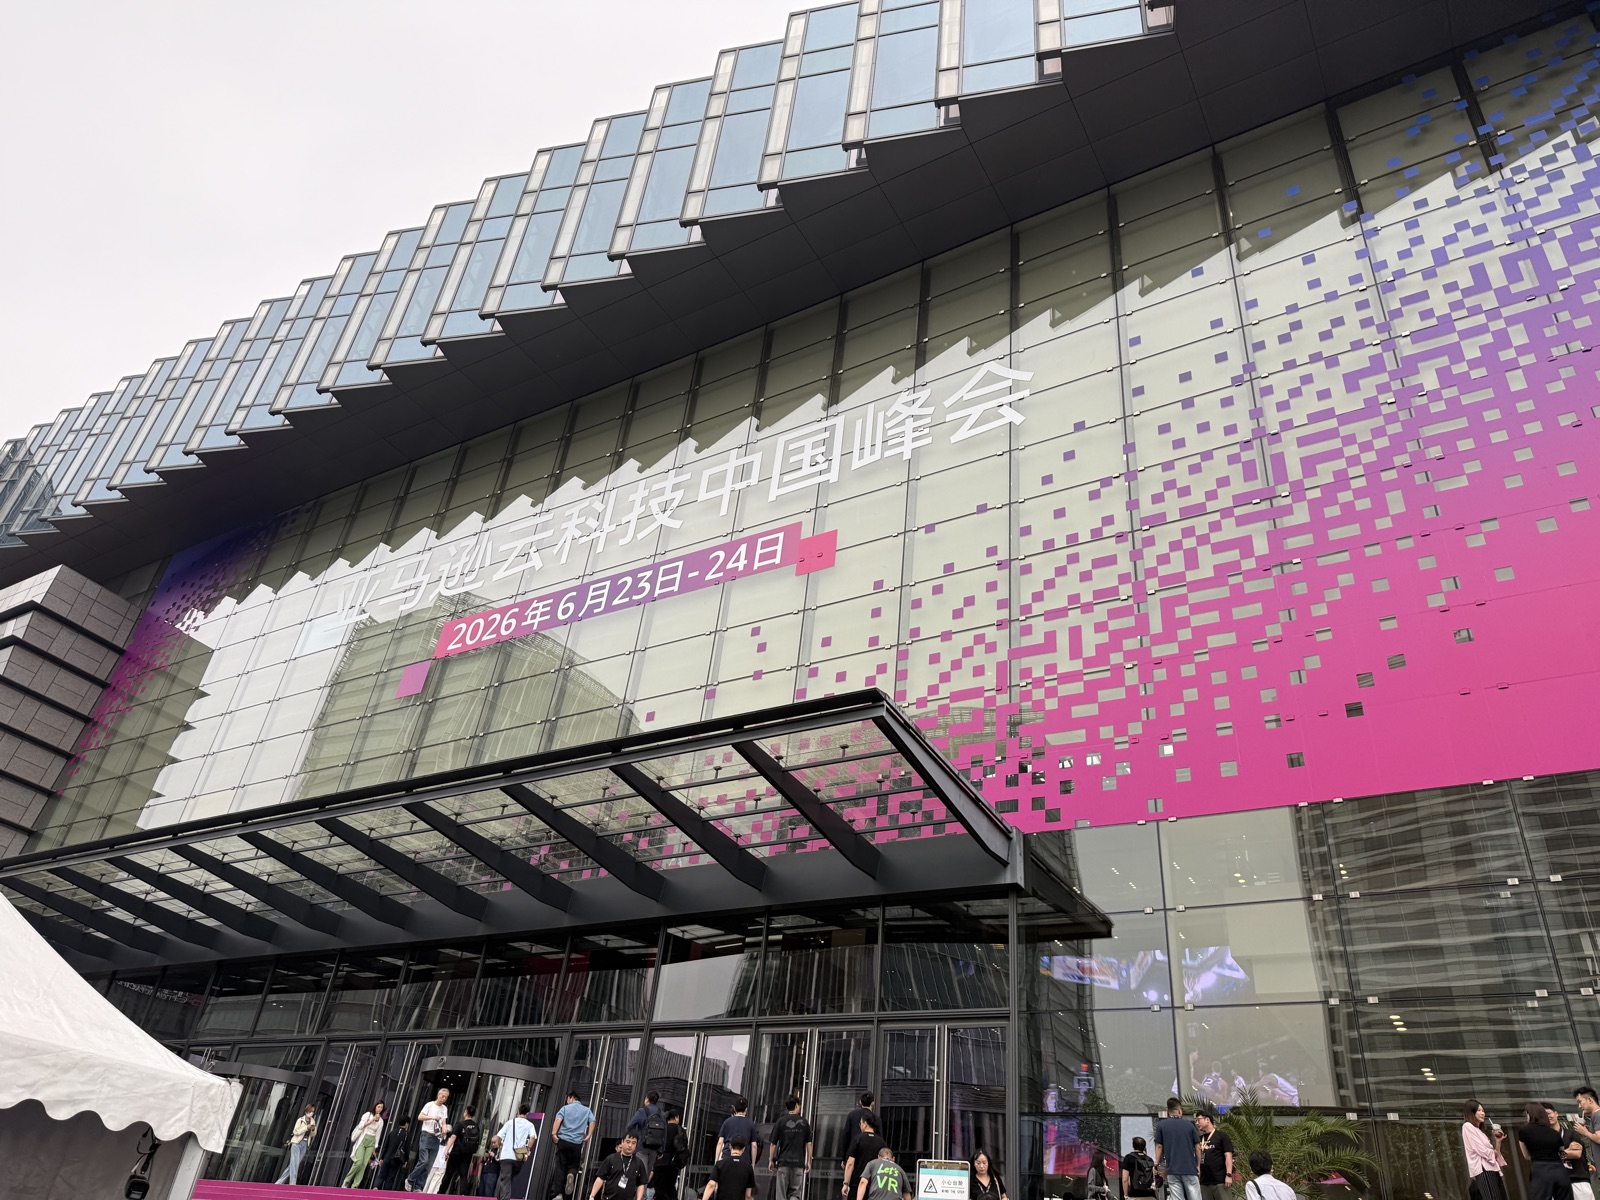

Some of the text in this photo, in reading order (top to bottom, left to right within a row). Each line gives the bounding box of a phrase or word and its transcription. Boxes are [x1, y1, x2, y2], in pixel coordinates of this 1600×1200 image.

[322, 360, 1036, 633] 亚马逊云科技中国峰会
[876, 1163, 899, 1177] Let's
[876, 1175, 898, 1193] VR
